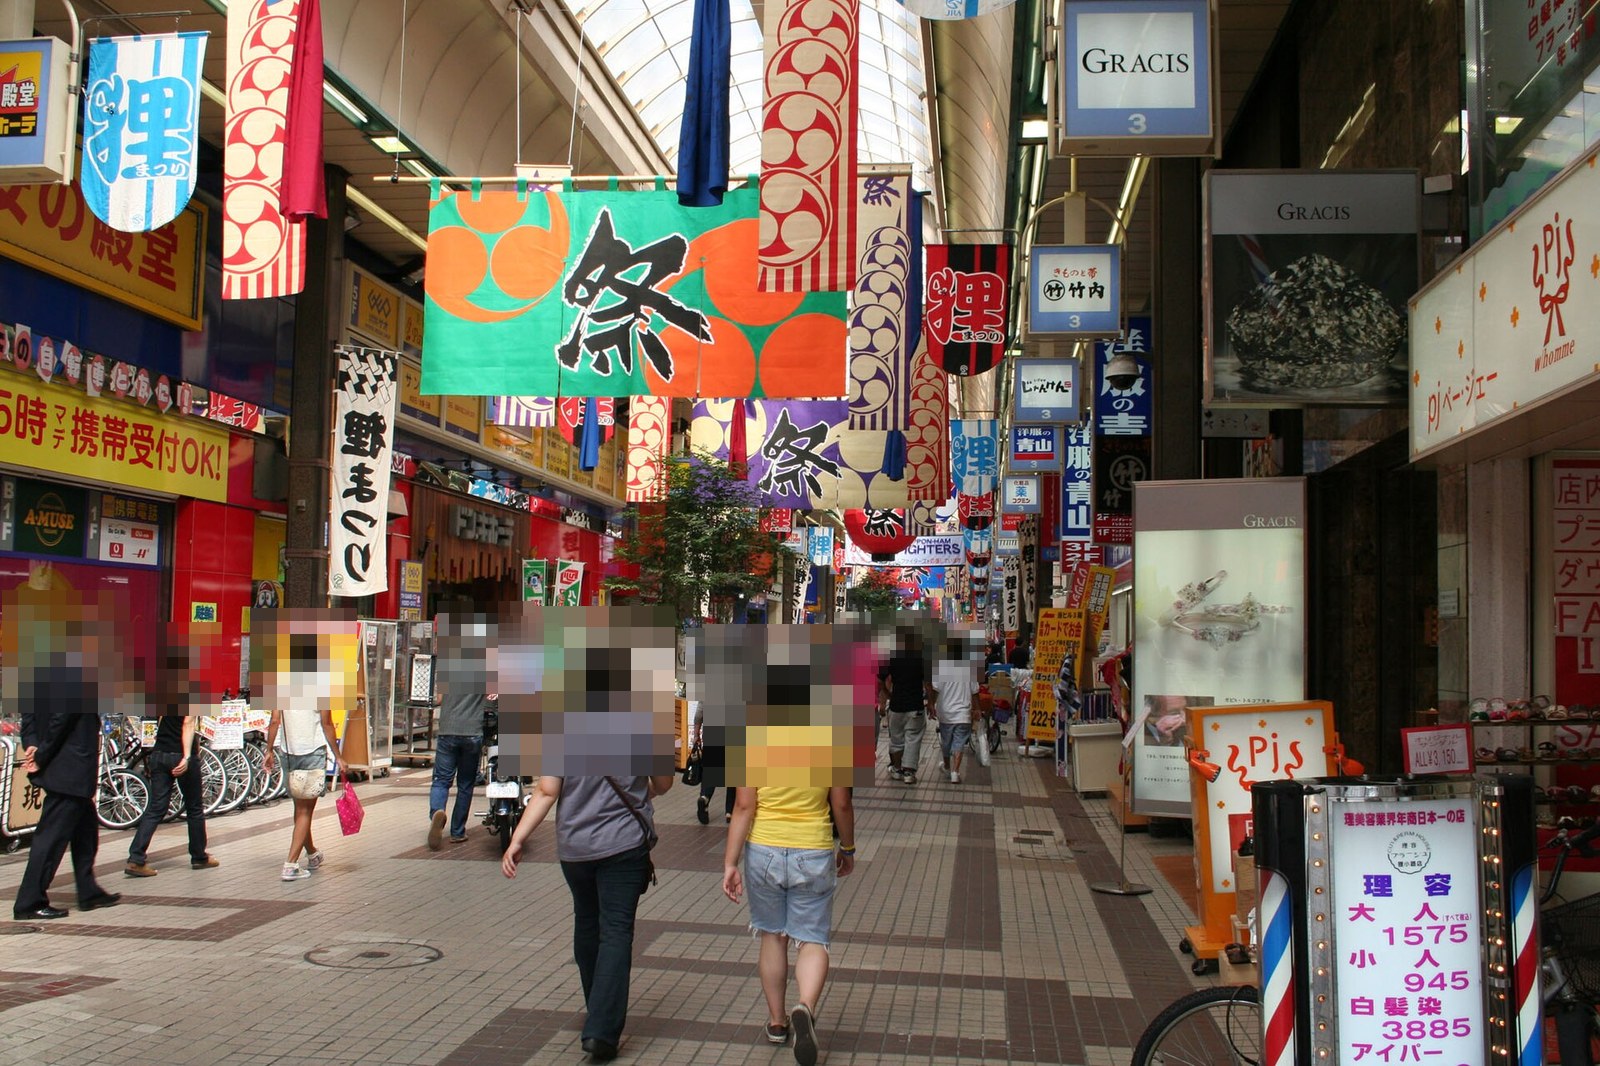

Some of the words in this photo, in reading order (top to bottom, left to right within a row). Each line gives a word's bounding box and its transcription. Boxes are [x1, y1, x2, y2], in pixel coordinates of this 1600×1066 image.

[1082, 48, 1190, 74] GRACIS
[1, 82, 36, 108] 殿堂
[1128, 113, 1147, 134] 3
[136, 164, 187, 177] まつり
[863, 177, 900, 207] 祭
[1277, 202, 1351, 221] GRACIS
[1053, 267, 1098, 280] きものと帯
[556, 204, 715, 384] 祭
[1068, 281, 1105, 300] 竹内
[1069, 315, 1082, 328] 3
[961, 331, 1000, 342] まつり
[1022, 380, 1069, 394] じゃんけん
[1042, 409, 1051, 419] 3
[1018, 427, 1051, 436] 洋服の
[759, 407, 843, 499] 祭
[1017, 438, 1053, 452] 青山
[1030, 460, 1038, 468] 3
[1015, 486, 1028, 497] 薬
[89, 506, 98, 540] 1F
[1097, 513, 1110, 521] 2F
[1243, 513, 1297, 528] GRACIS
[1097, 528, 1110, 536] 1F
[1004, 575, 1018, 628] 狸まつり
[22, 783, 43, 811] 現
[1344, 809, 1466, 827] 理美容業界年商日本一の店
[1382, 923, 1468, 946] 1575
[1403, 970, 1470, 993] 945
[1350, 996, 1442, 1016] 白髪染
[1382, 1017, 1472, 1040] 3885
[1351, 1042, 1443, 1063] アイパー
